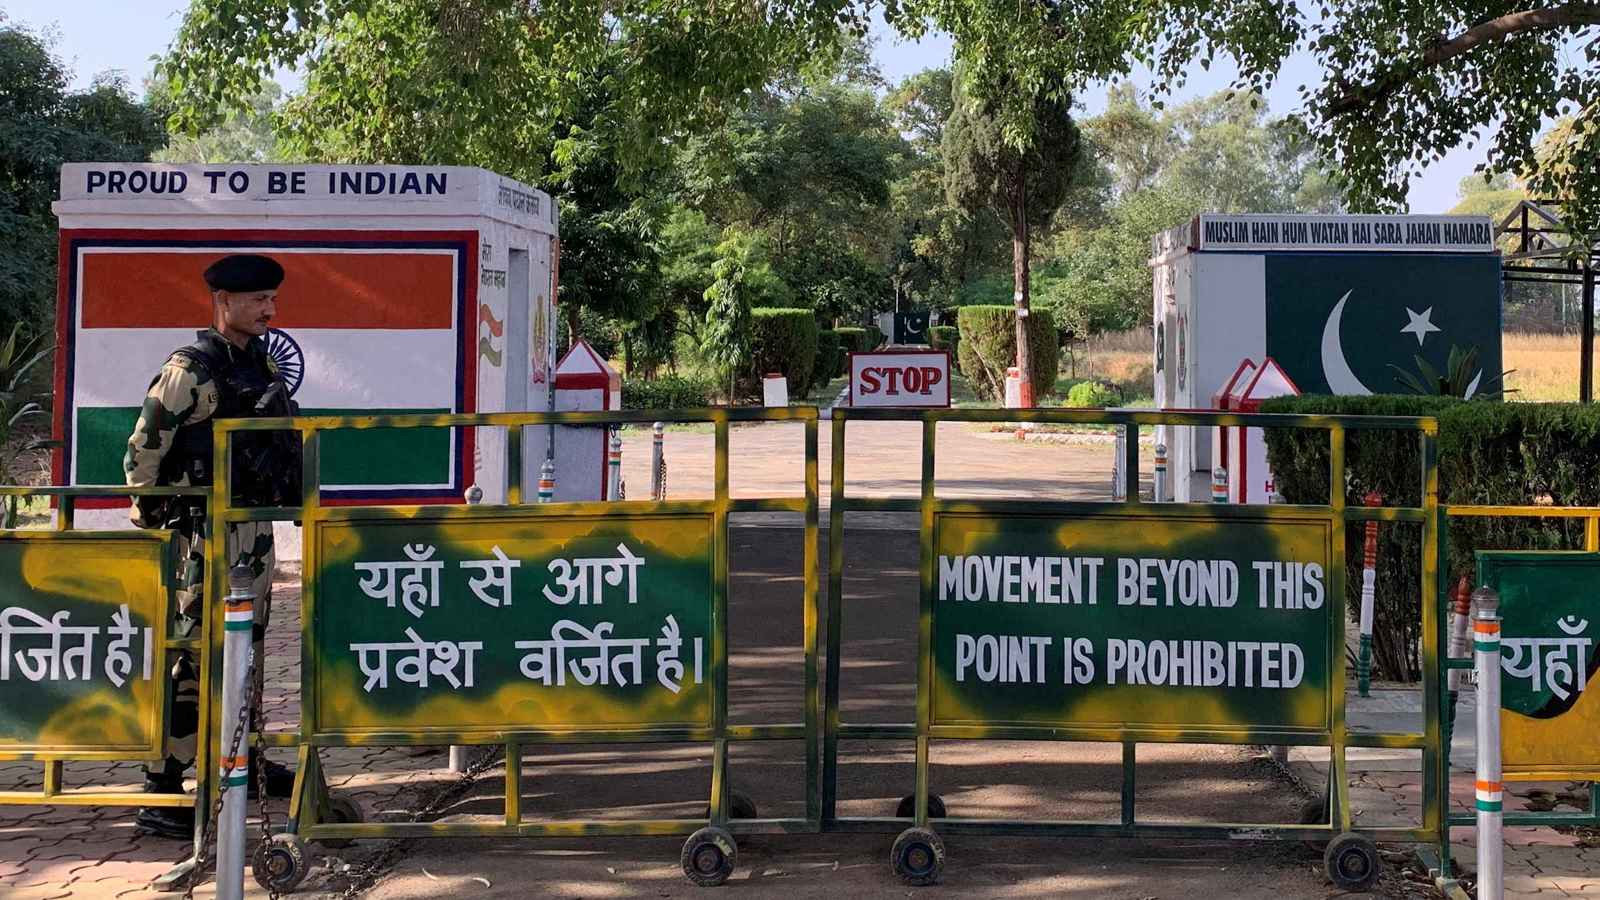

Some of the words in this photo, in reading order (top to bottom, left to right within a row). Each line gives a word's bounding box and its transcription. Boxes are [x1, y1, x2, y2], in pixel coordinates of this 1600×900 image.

[86, 170, 188, 194] PROUD
[203, 170, 250, 194] TO
[267, 171, 307, 195] BE
[329, 171, 448, 195] INDIAN
[1205, 221, 1249, 243] MUSLIM
[1252, 221, 1279, 243] HAIN
[1282, 221, 1308, 243] HUM
[1310, 222, 1349, 244] WATAN
[1352, 222, 1371, 244] HAI
[1374, 222, 1403, 244] SARA
[1405, 223, 1441, 244] JAHAN
[1443, 223, 1492, 244] HAMARA
[859, 366, 942, 396] STOP
[354, 543, 444, 618] यहाँ
[459, 545, 521, 607] से
[542, 543, 645, 606] आगे
[938, 555, 1104, 605] MOVEMENT
[1117, 557, 1239, 608] BEYOND
[1252, 560, 1324, 610] THIS
[0, 606, 100, 681] र्जित
[349, 627, 483, 692] प्रवेश
[514, 619, 650, 687] वर्जित
[956, 634, 1052, 684] POINT
[1063, 637, 1095, 685] IS
[1107, 638, 1305, 689] PROHIBITED
[1500, 615, 1593, 701] यहाँ
